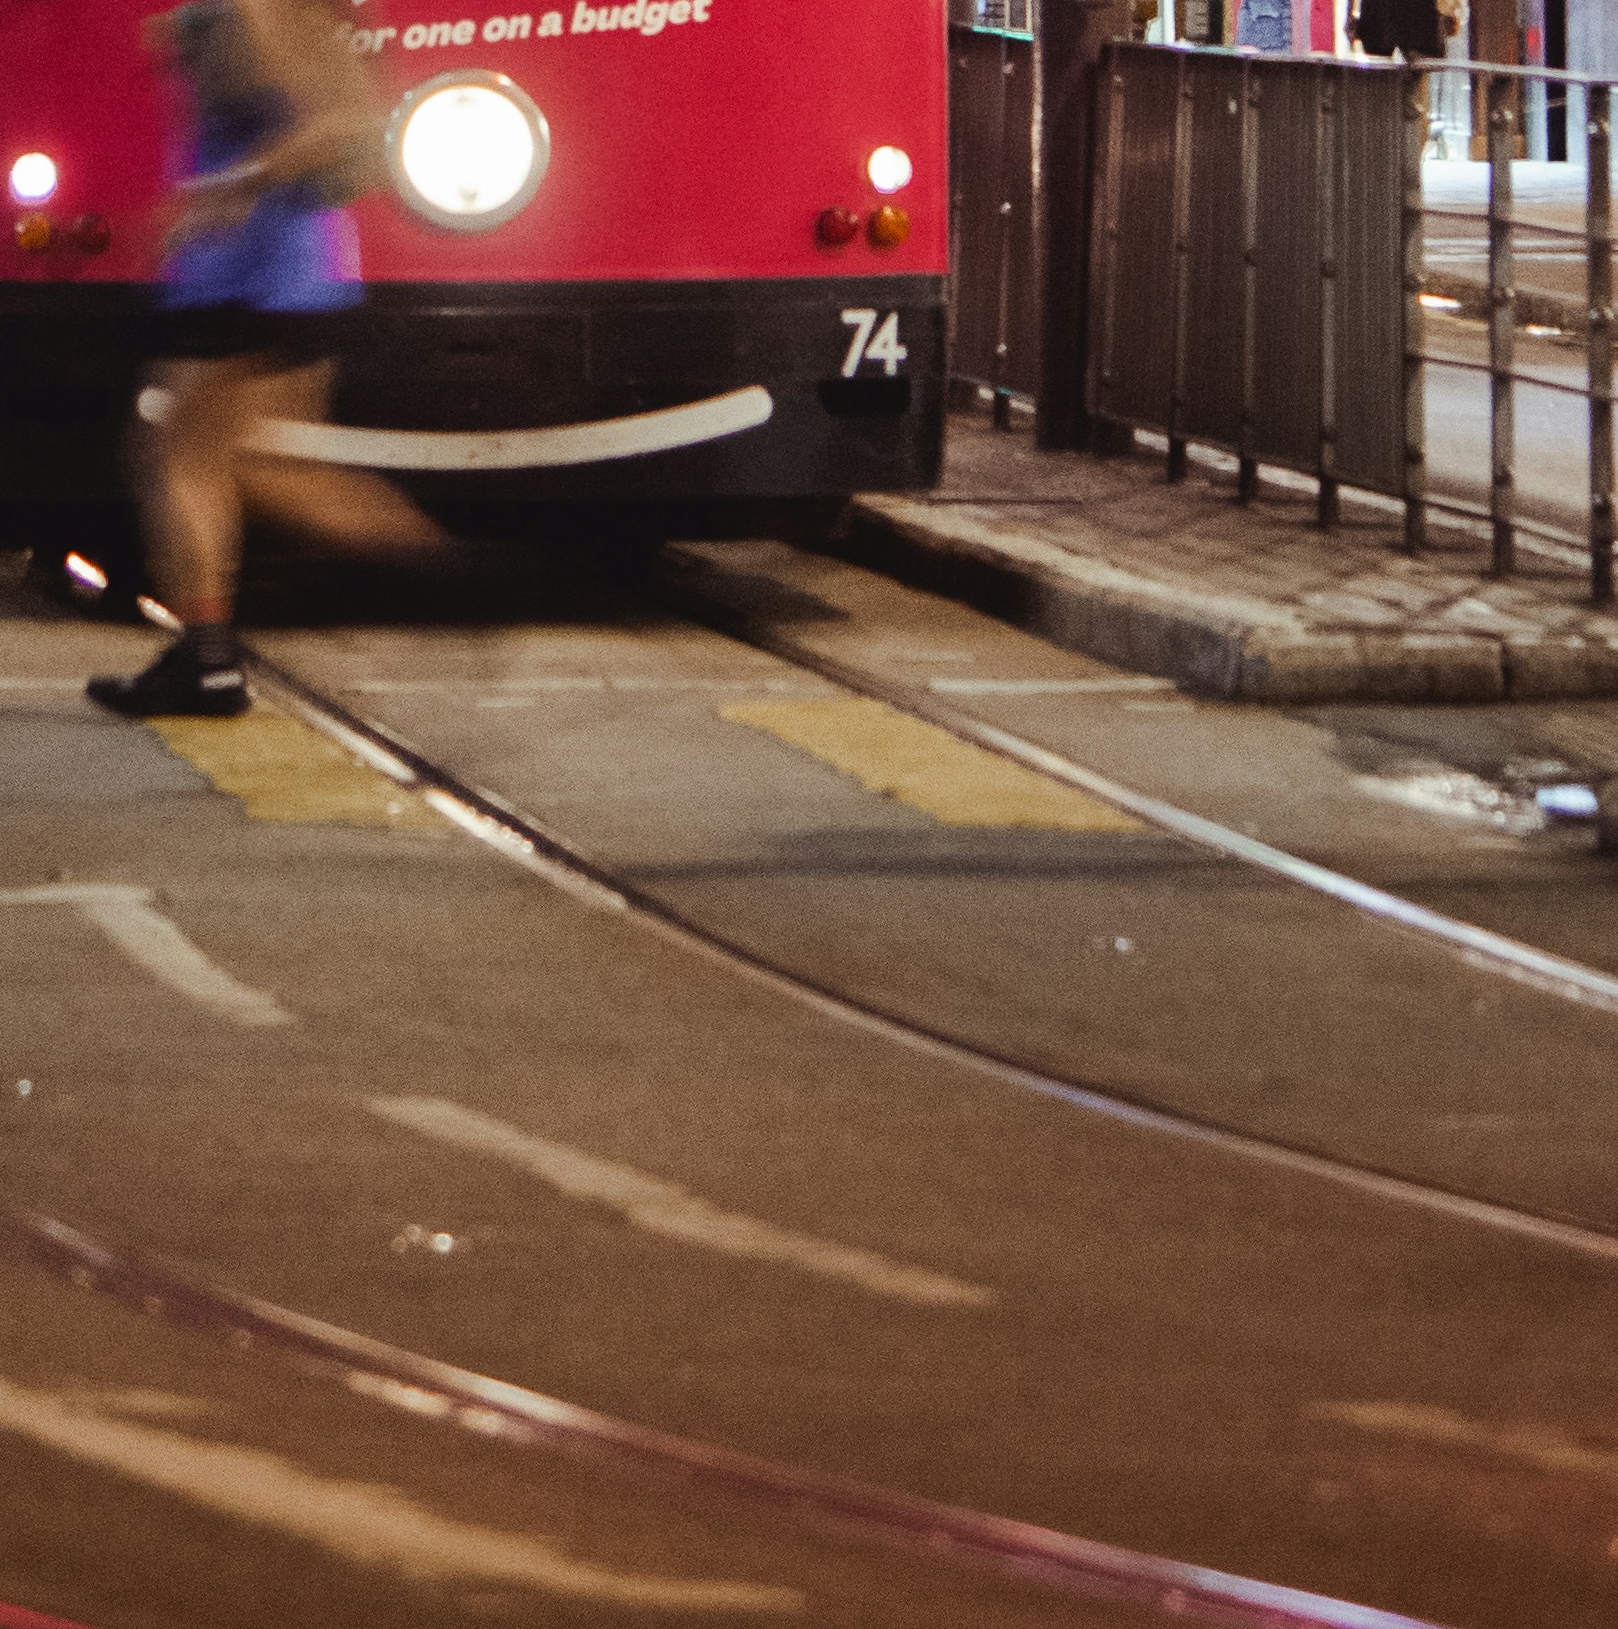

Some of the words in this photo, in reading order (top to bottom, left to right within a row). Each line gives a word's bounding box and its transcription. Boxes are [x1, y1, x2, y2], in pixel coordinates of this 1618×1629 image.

[402, 16, 477, 51] one
[482, 12, 533, 44] on
[537, 8, 564, 39] a
[840, 307, 909, 378] 74
